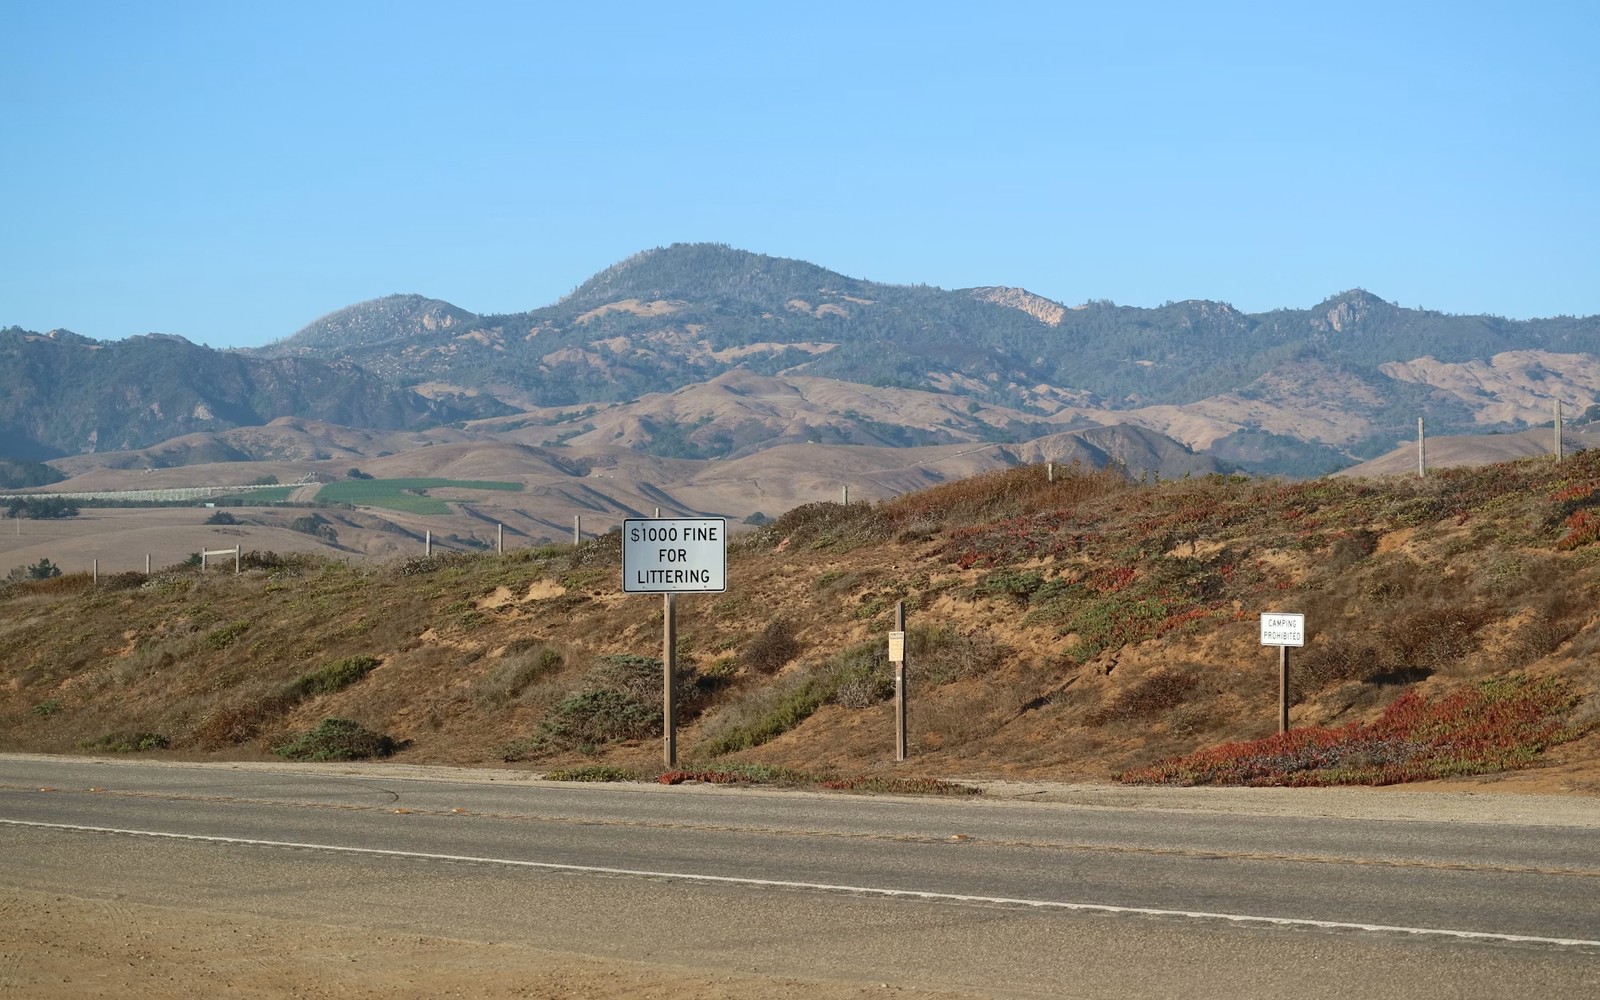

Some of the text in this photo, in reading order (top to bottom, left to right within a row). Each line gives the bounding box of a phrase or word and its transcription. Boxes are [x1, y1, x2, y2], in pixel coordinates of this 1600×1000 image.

[630, 527, 718, 542] $1000 FINE
[659, 548, 687, 562] FOR
[637, 569, 710, 584] LITTERING
[1268, 619, 1296, 628] CAMPING
[1263, 631, 1301, 640] PROHIBITED
